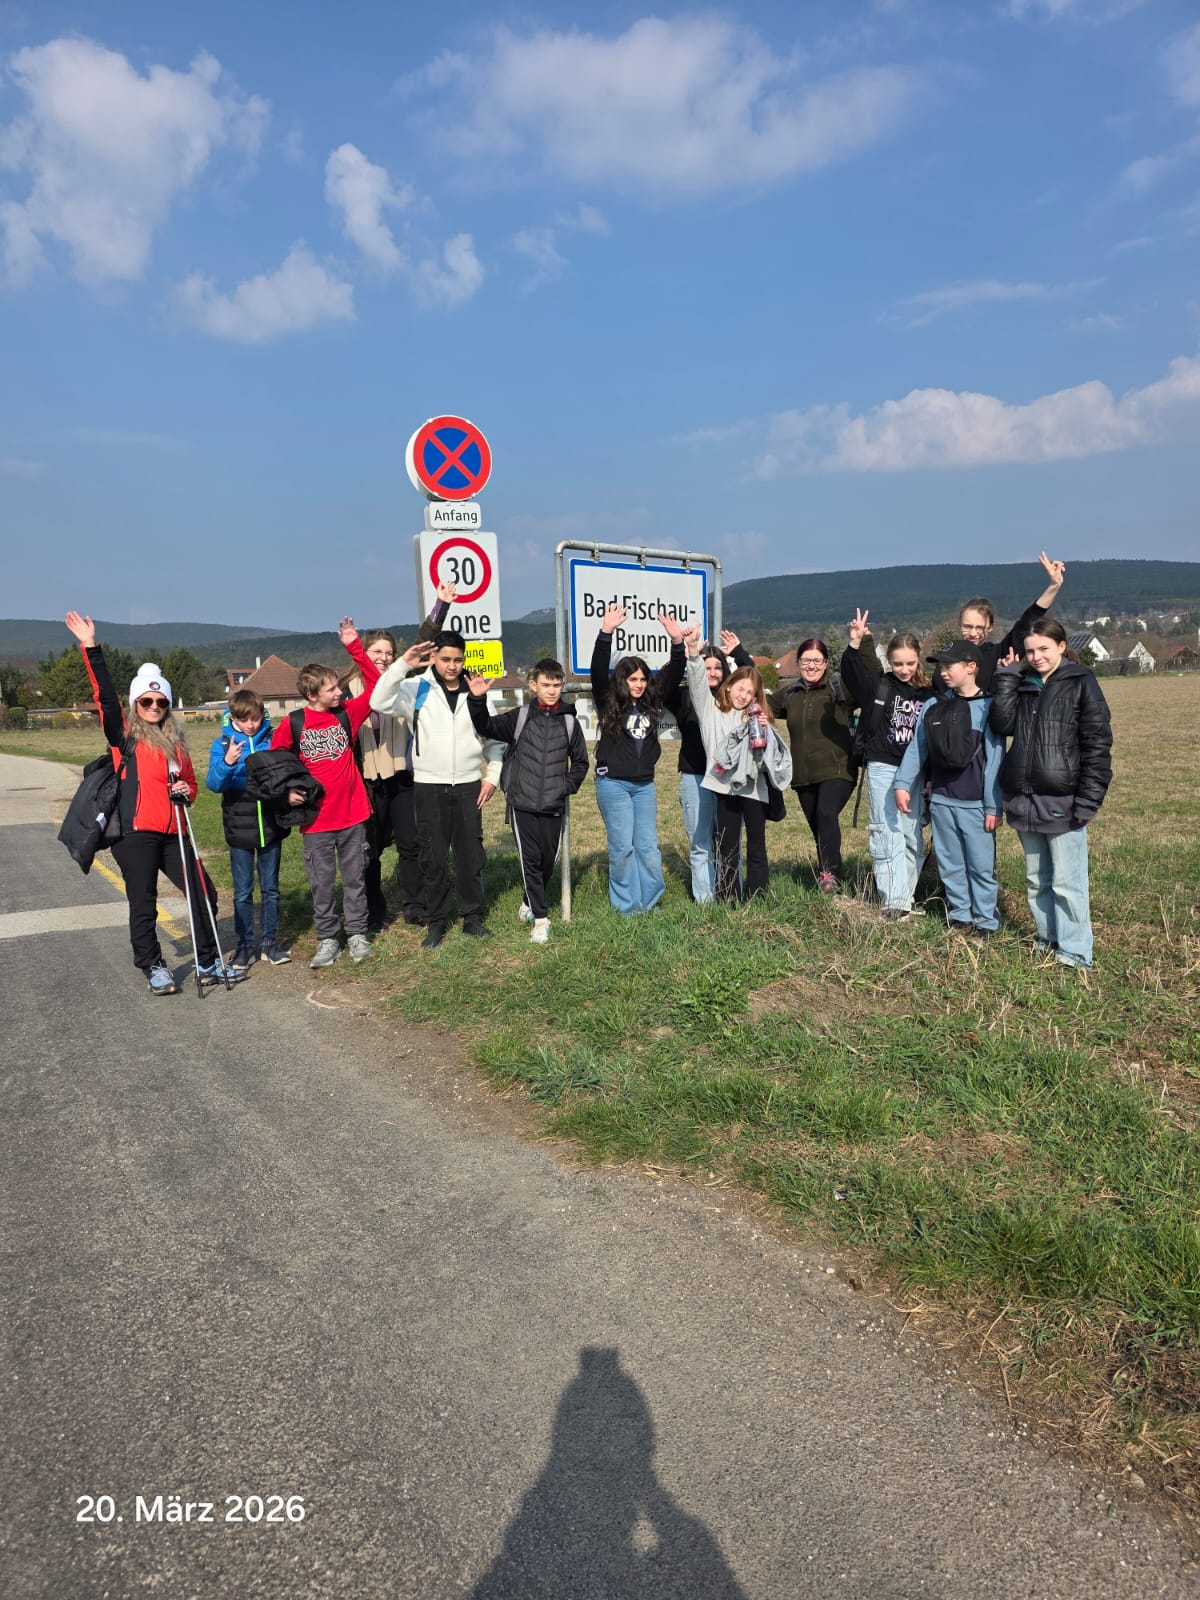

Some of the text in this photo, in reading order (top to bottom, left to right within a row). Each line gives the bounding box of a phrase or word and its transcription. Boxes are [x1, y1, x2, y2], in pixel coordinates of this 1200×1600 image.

[434, 509, 478, 523] Anfang
[446, 557, 476, 586] 30
[623, 594, 696, 622] Fischau-
[450, 614, 491, 634] one
[616, 628, 668, 652] Brunn
[465, 649, 484, 660] ung
[465, 661, 503, 674] orrang!
